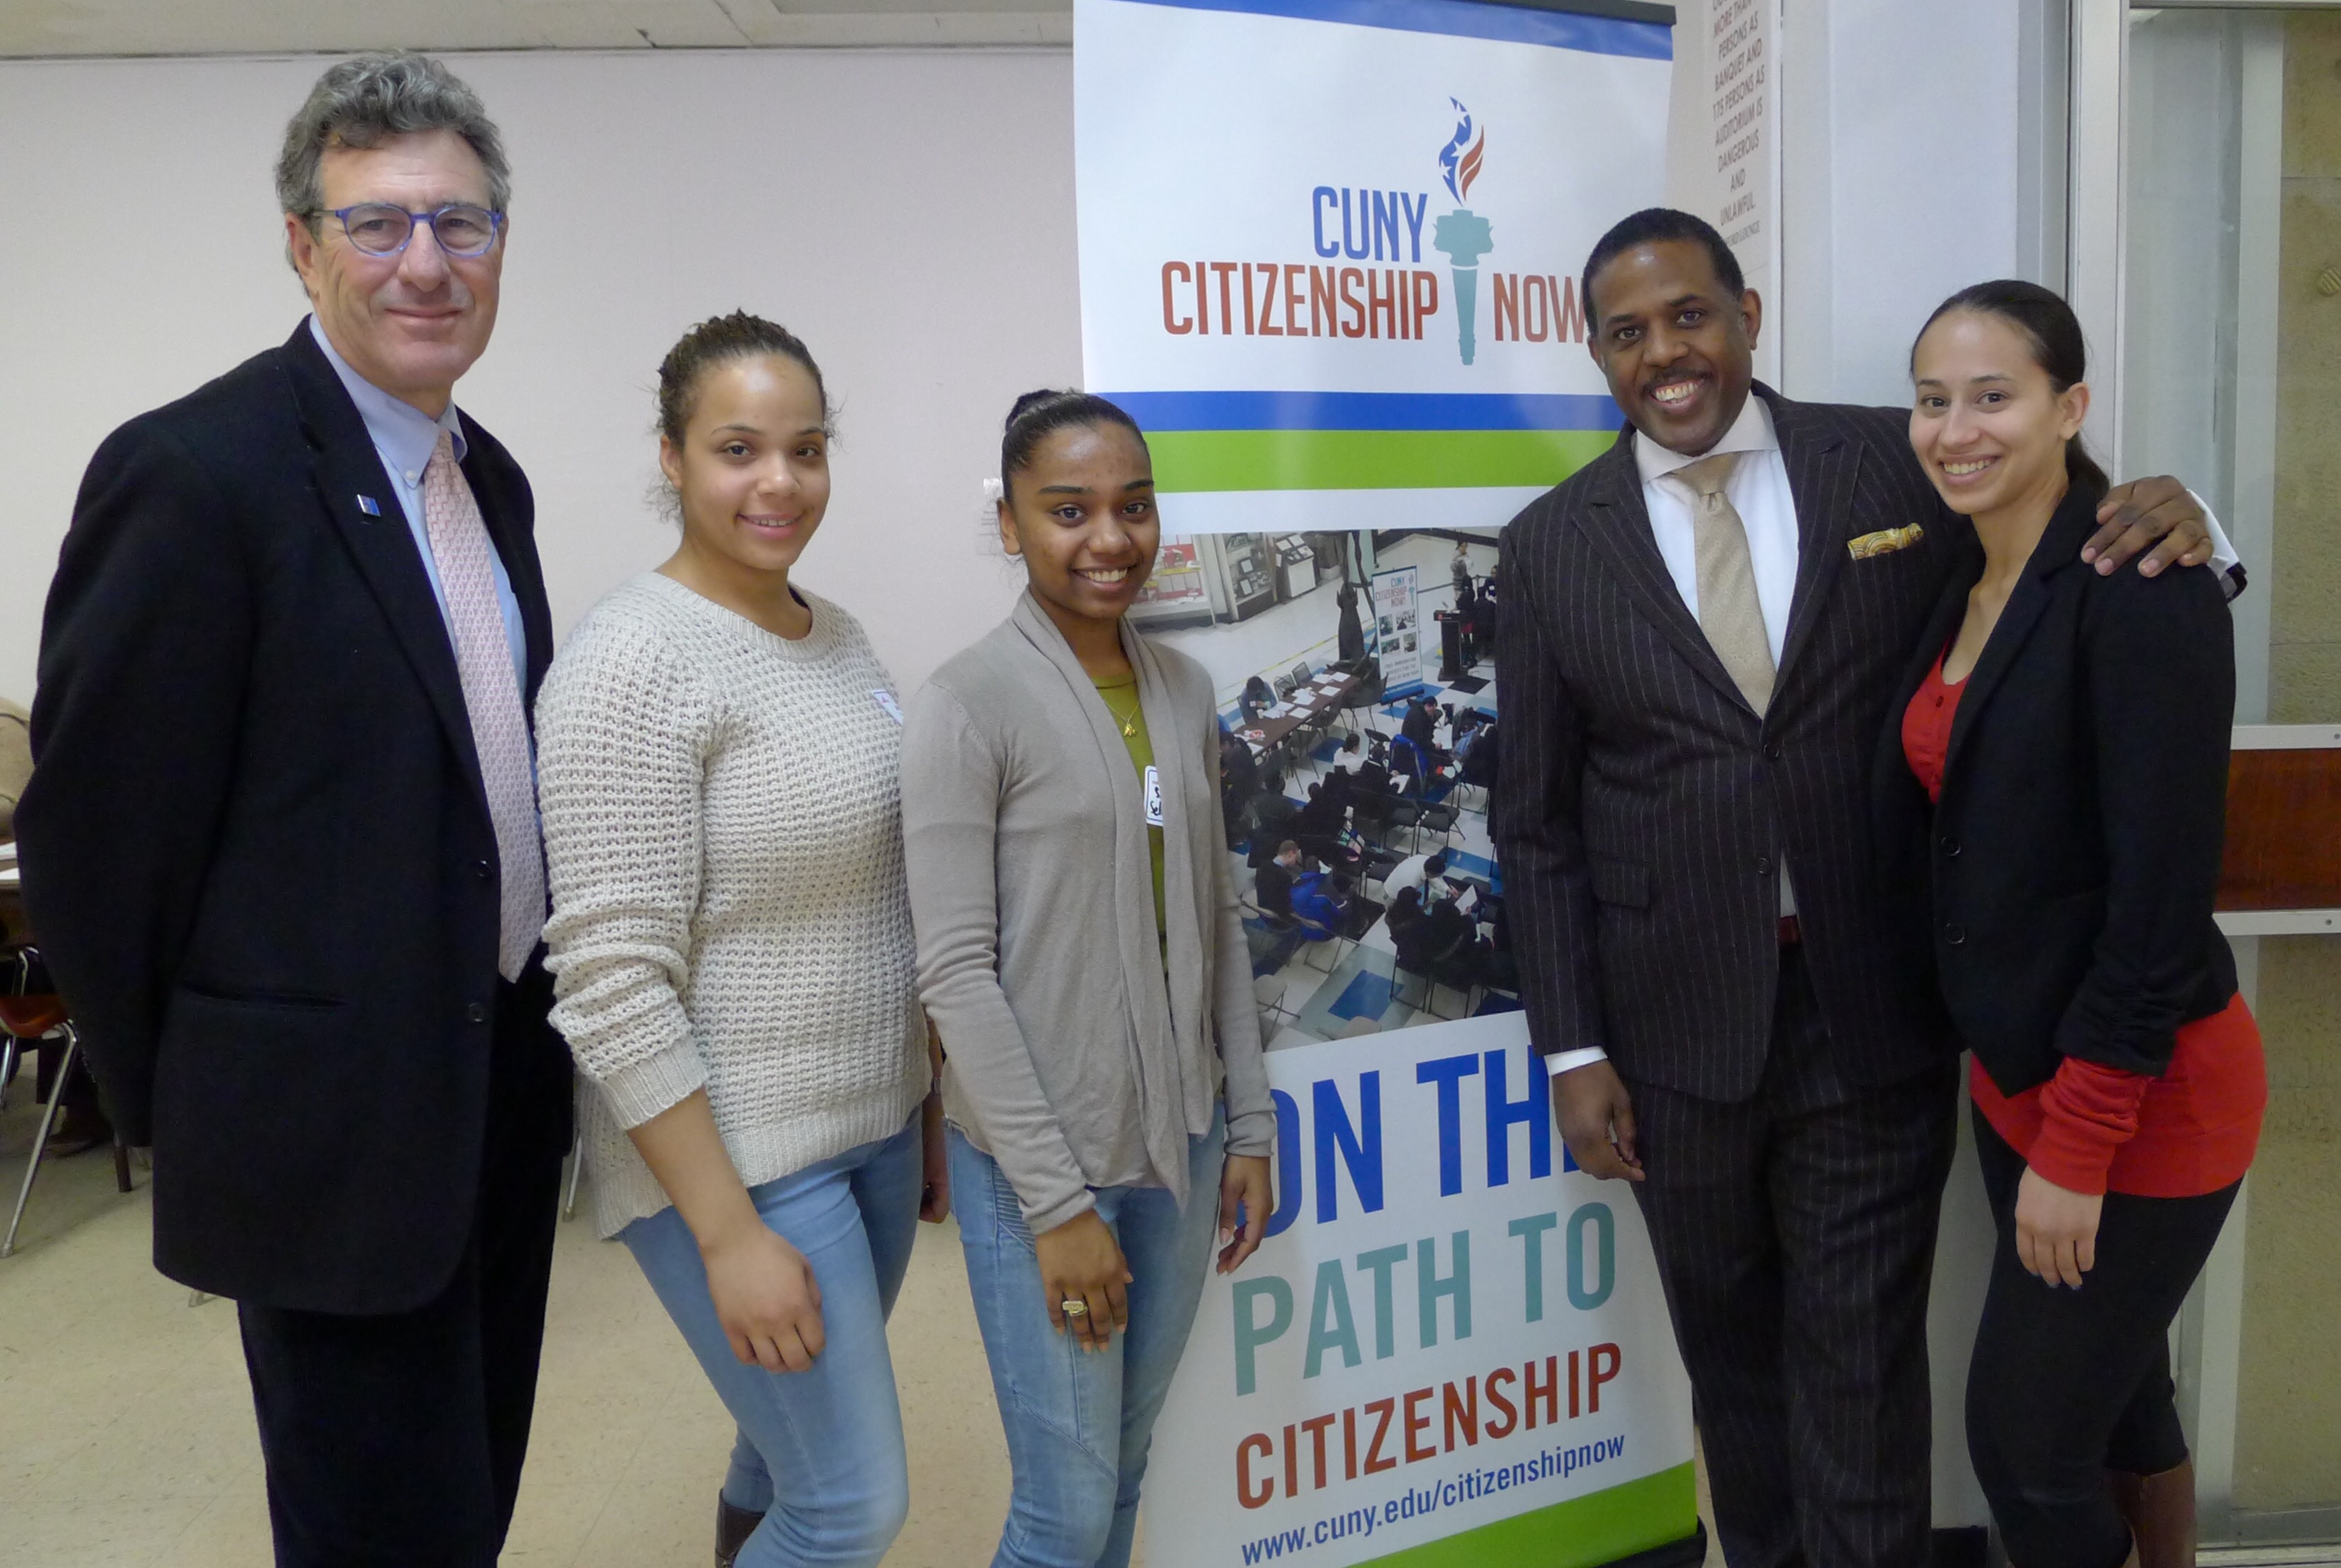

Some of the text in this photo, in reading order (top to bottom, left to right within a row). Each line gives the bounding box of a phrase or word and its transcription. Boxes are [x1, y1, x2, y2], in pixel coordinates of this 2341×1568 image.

[1713, 5, 1732, 38] MORE
[1718, 10, 1759, 62] PERSONS AS
[1713, 63, 1765, 122] 175 PERSONS AS
[1715, 38, 1762, 92] BANQUET AND
[1715, 95, 1763, 148] AUDITORIUM IS
[1718, 128, 1759, 173] DANGEROUS
[1730, 168, 1746, 192] AND
[1313, 186, 1427, 263] CUNY
[1161, 261, 1439, 341] CITIZENSHIP
[1390, 575, 1406, 588] CUNY
[1416, 1044, 1582, 1197] TH
[1231, 1201, 1616, 1397] PATH TO
[1235, 1342, 1622, 1511] CITIZENSHIP
[1241, 1435, 1626, 1567] www.cuny.edu/citizenshipnow
